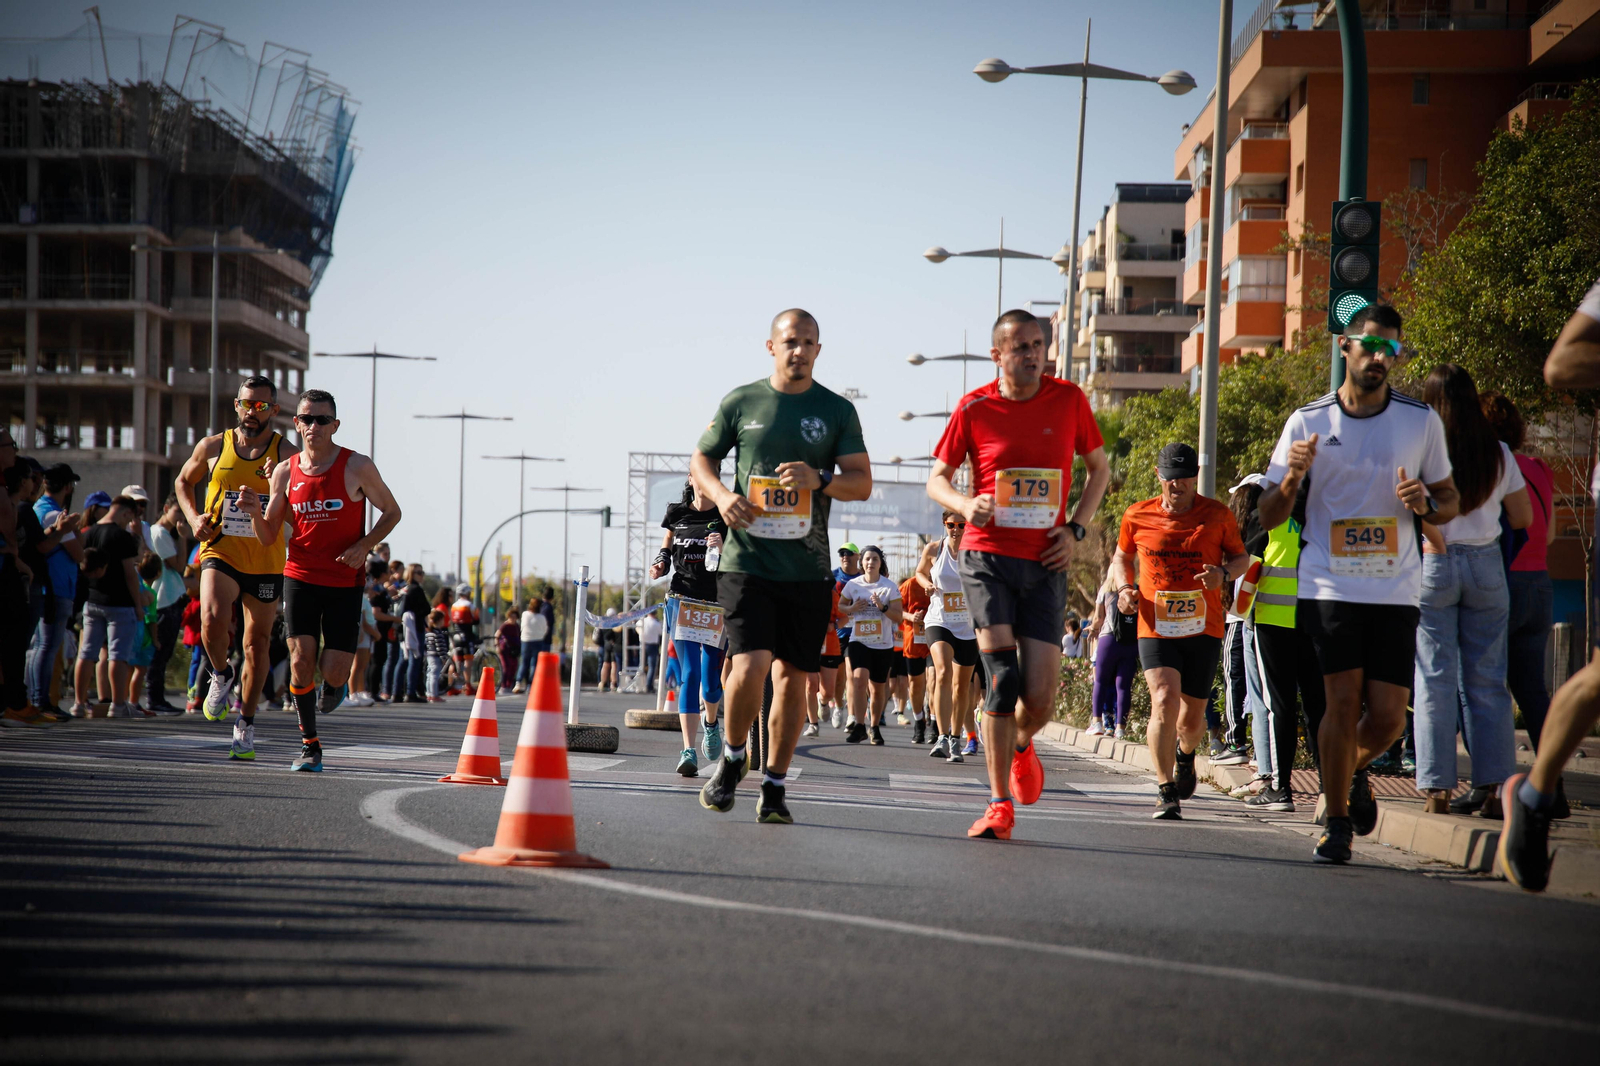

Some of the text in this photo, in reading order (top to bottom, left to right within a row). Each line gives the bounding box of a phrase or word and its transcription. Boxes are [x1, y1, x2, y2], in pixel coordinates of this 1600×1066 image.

[1011, 478, 1049, 496] 179
[762, 488, 799, 506] 180
[1345, 527, 1385, 545] 549
[1166, 600, 1196, 613] 725
[684, 609, 720, 626] 1351
[860, 623, 877, 632] 838
